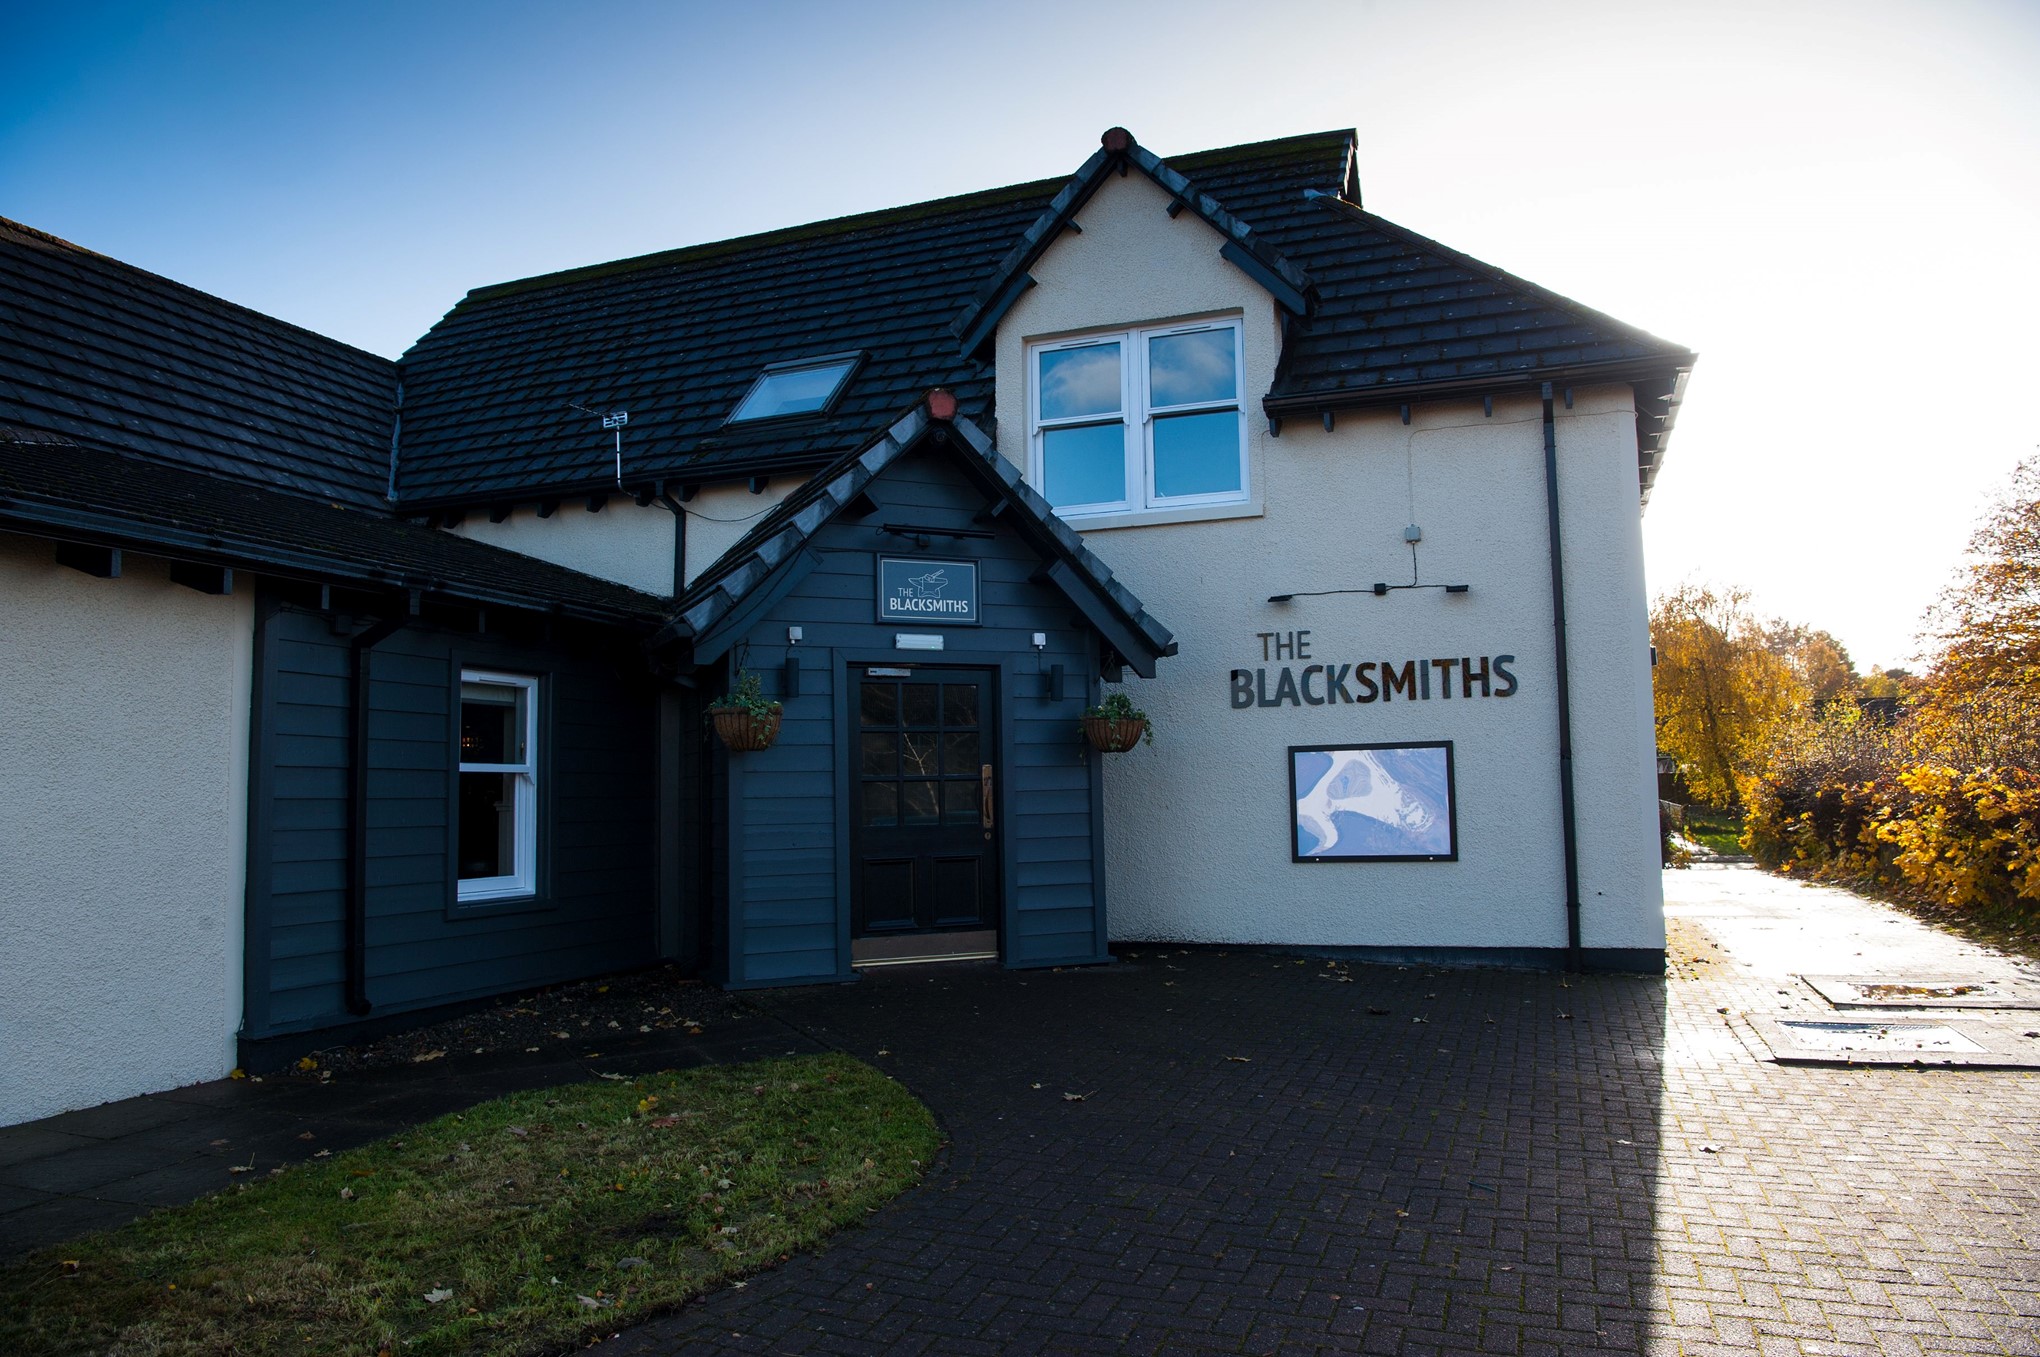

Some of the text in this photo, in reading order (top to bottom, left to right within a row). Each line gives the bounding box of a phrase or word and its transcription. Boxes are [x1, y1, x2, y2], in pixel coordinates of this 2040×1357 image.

[897, 587, 914, 598] THE
[889, 597, 969, 613] BLACKSMITHS
[1257, 630, 1311, 661] THE
[1230, 654, 1518, 709] BLACKSMITHS
